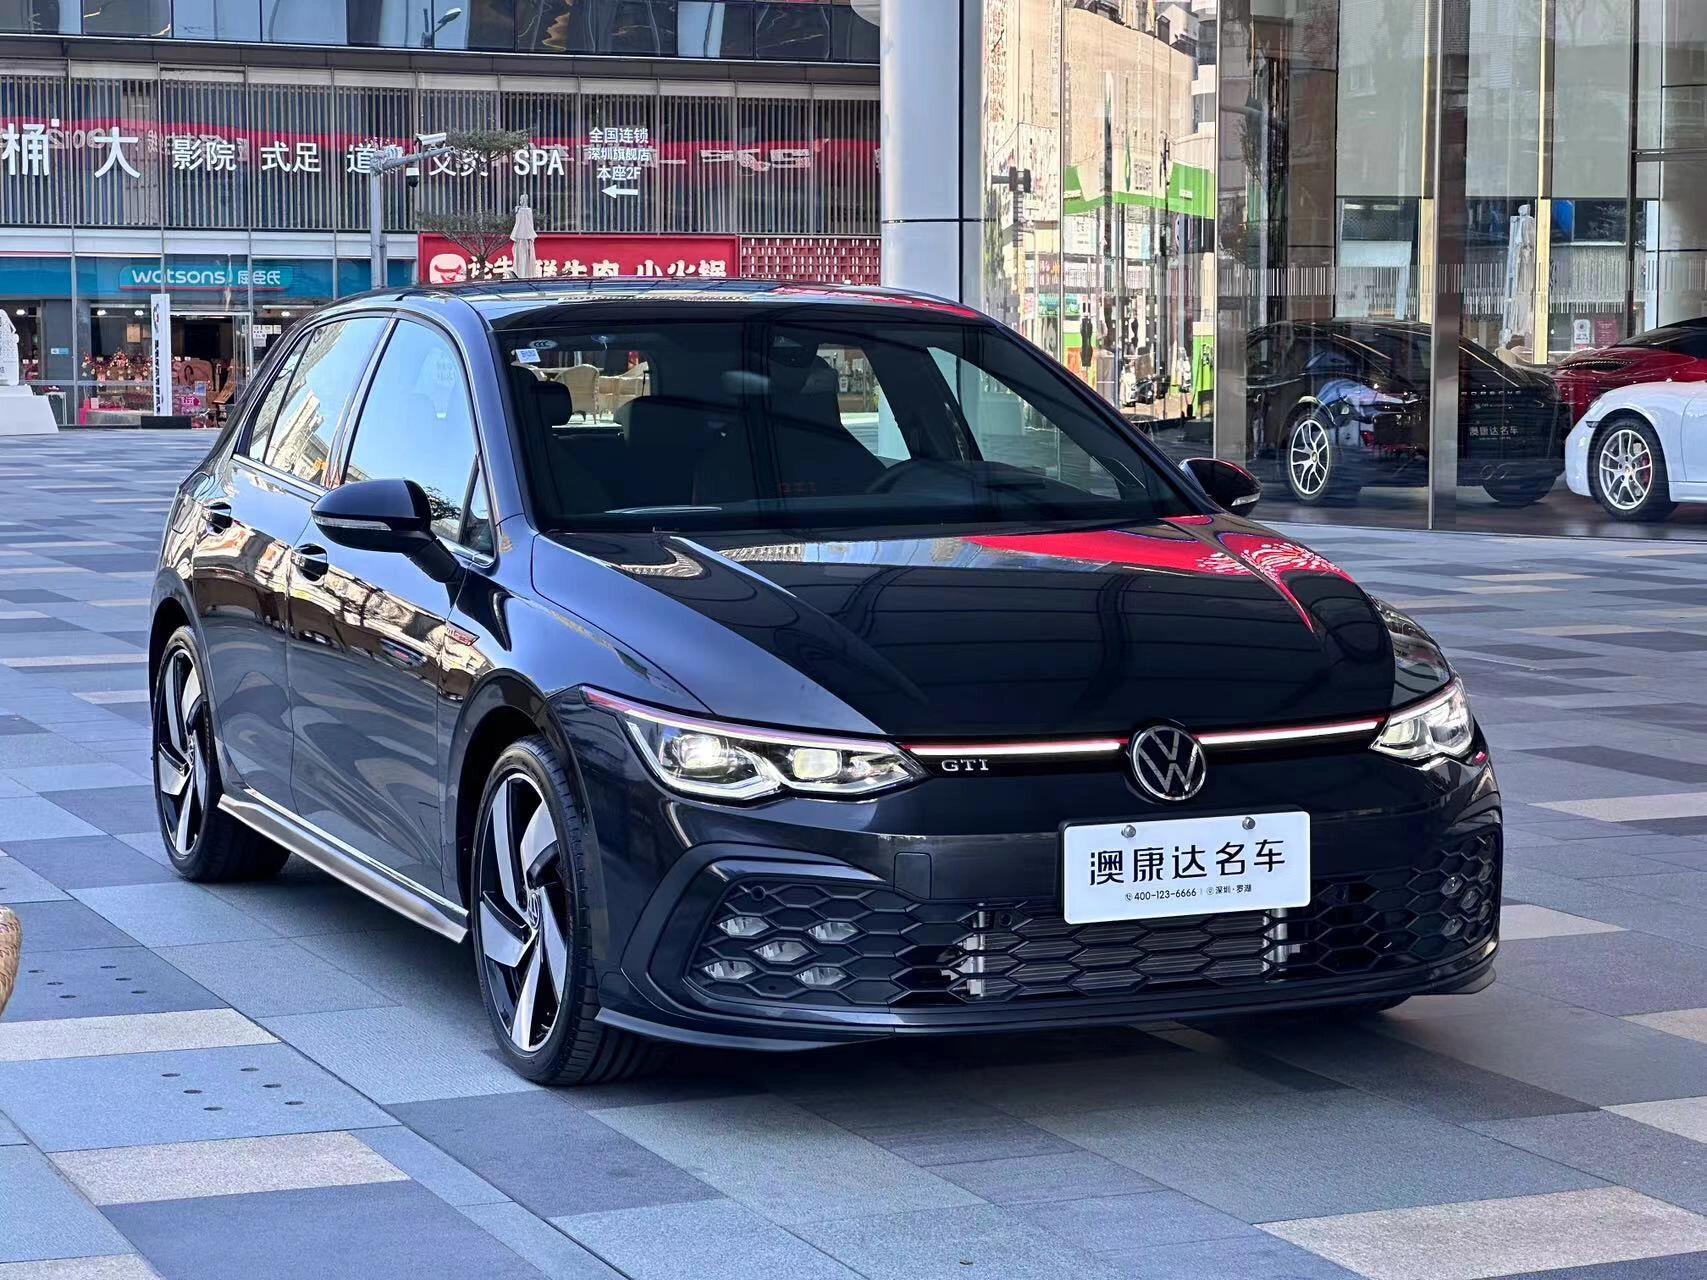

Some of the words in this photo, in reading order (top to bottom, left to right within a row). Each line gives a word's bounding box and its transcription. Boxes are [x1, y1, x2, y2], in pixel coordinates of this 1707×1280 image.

[588, 127, 649, 144] 全国连锁
[93, 126, 141, 178] 大
[172, 138, 237, 172] 影院
[260, 140, 322, 172] 式足
[513, 149, 565, 176] SPA
[588, 147, 651, 162] 深圳旗舰店
[596, 165, 642, 181] 本座2F
[131, 270, 226, 285] watsons
[940, 758, 990, 773] GTI
[1089, 838, 1286, 887] 澳康达名车
[1133, 887, 1197, 901] 400-123-6666
